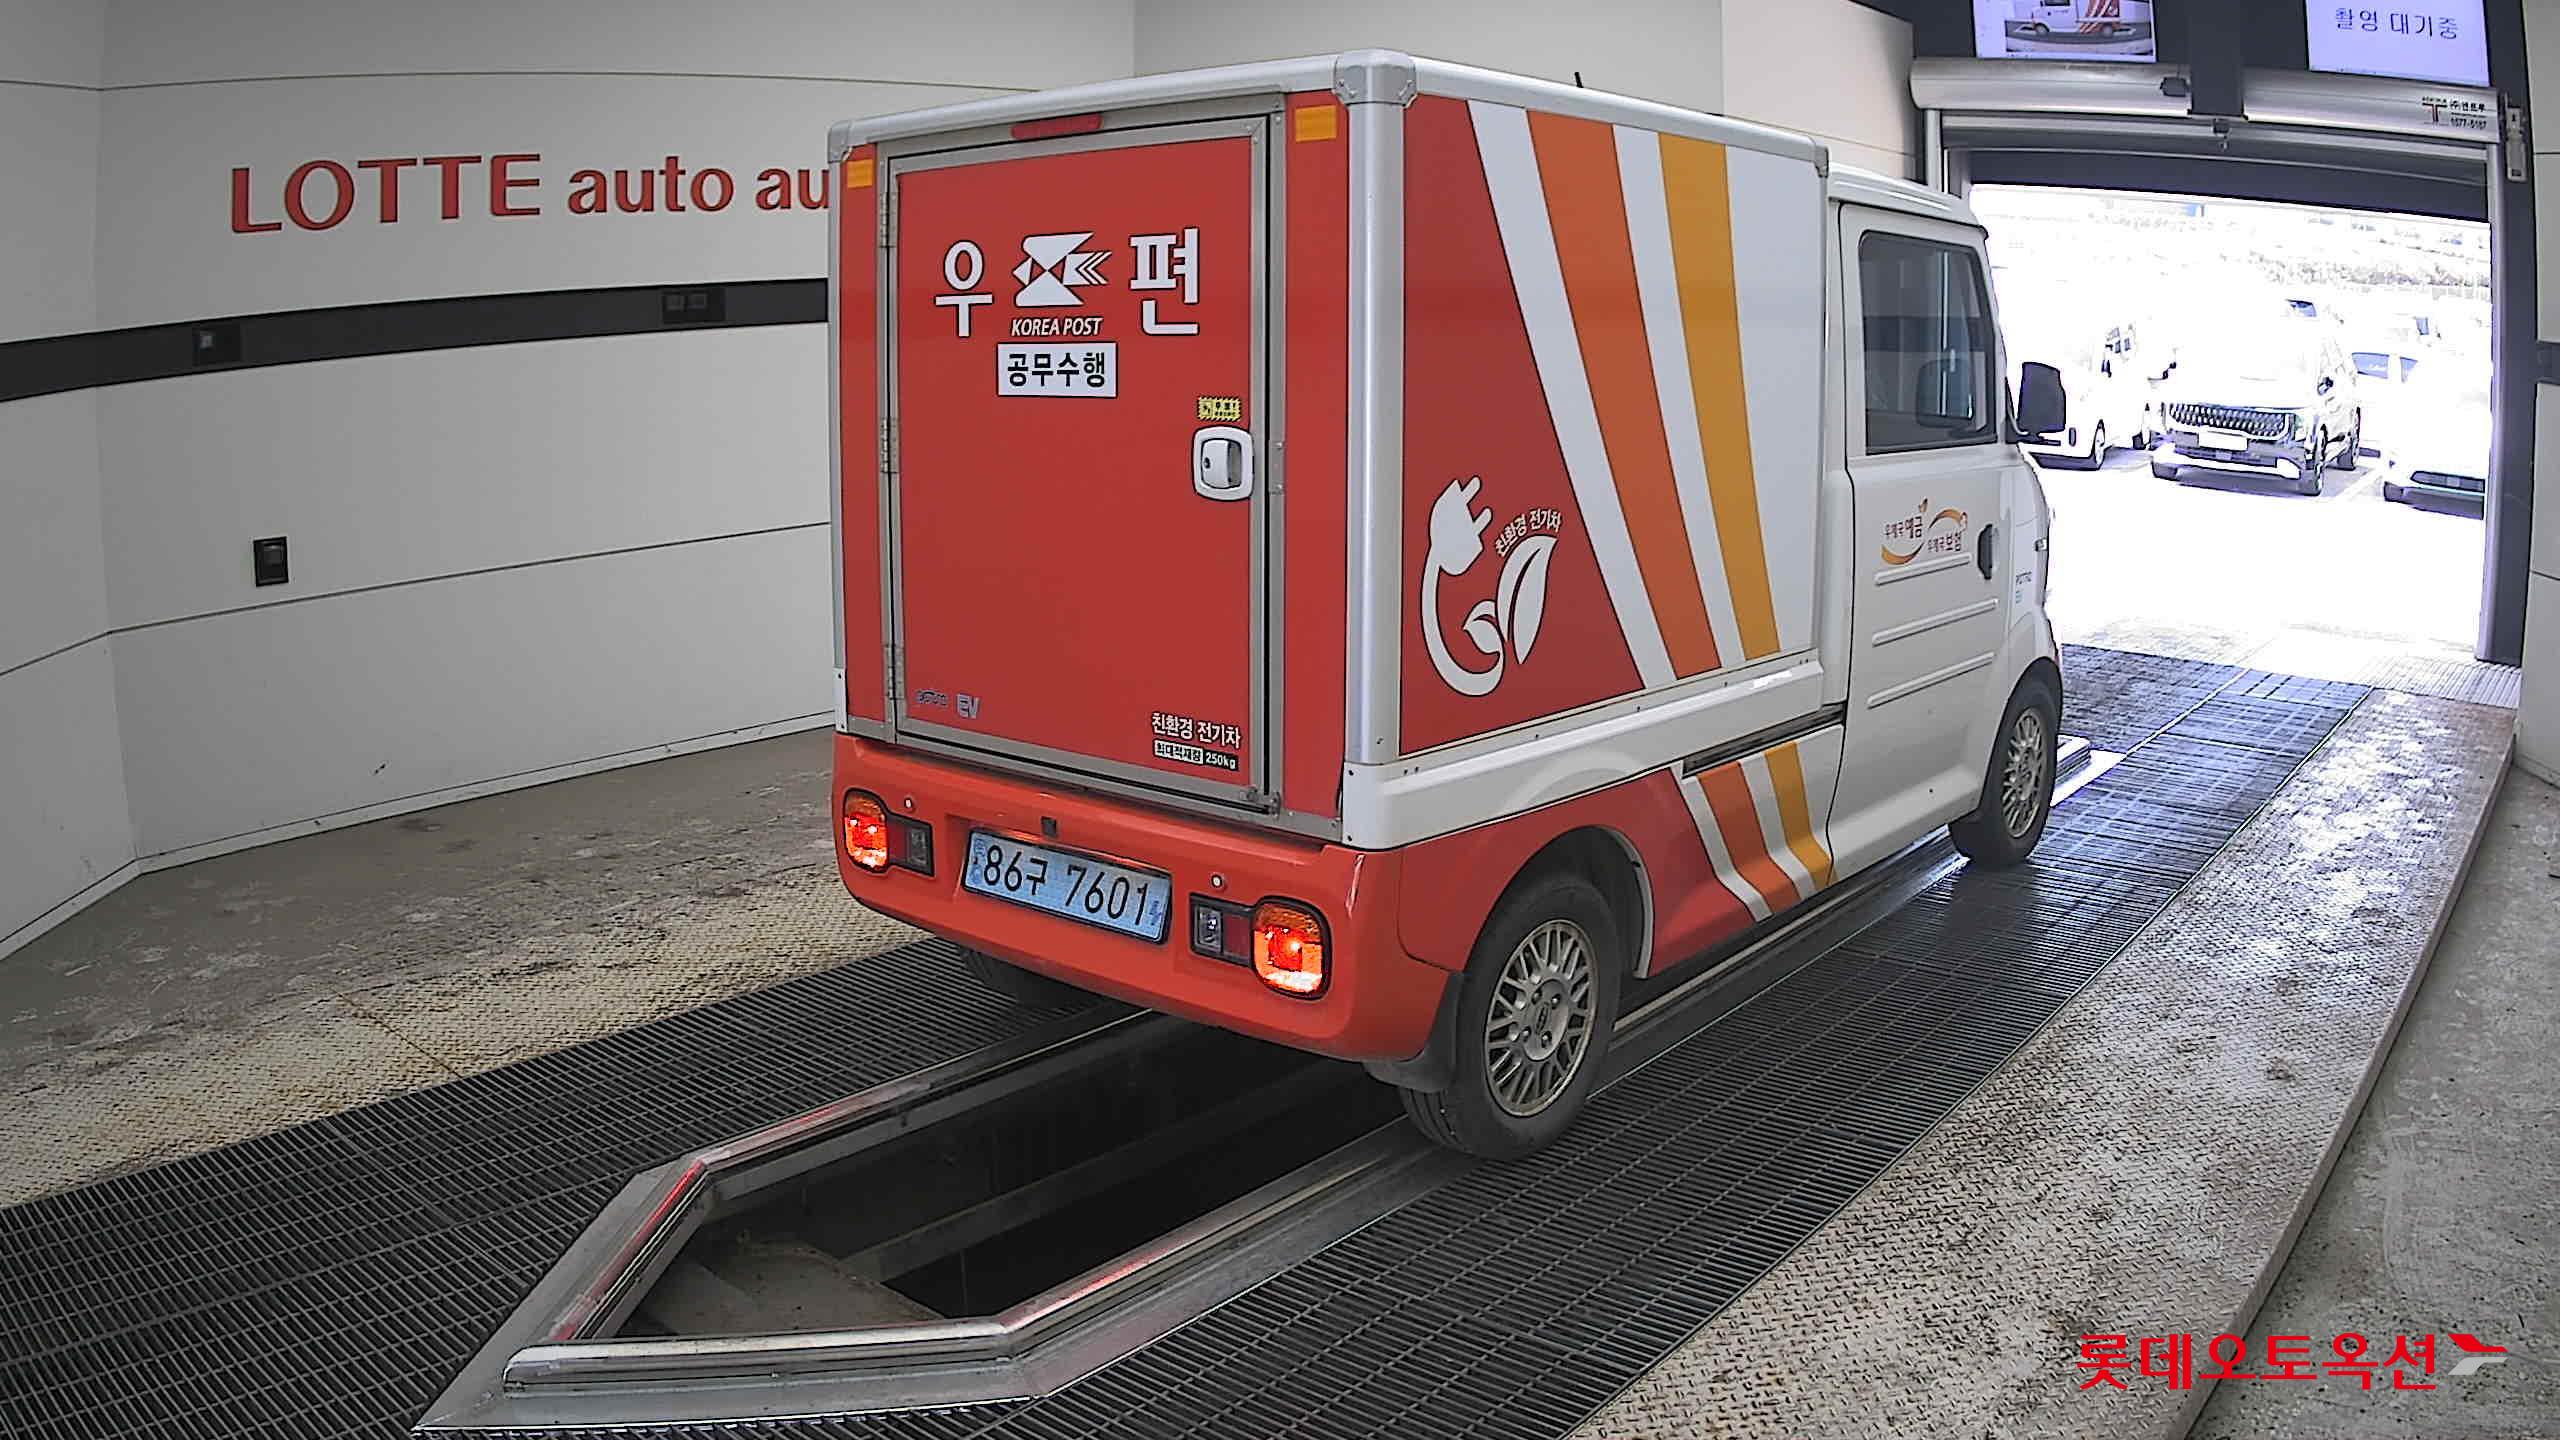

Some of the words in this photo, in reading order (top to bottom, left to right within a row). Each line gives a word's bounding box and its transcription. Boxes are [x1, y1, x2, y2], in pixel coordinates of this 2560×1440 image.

[2336, 8, 2379, 32] 촬영
[2390, 13, 2457, 39] 대기중
[231, 153, 541, 234] LOTTE
[568, 155, 735, 214] auto
[1011, 317, 1061, 337] KOREA
[1062, 316, 1104, 336] POST
[1007, 351, 1105, 388] 공무수행
[1495, 513, 1528, 557] 친환경
[1529, 508, 1562, 533] 전기차
[956, 693, 980, 719] EV
[1151, 712, 1193, 740] 친환경
[1197, 721, 1241, 749] 전기차
[1205, 751, 1237, 770] 250kg
[984, 844, 1048, 895] 86구
[1064, 863, 1149, 926] 7601
